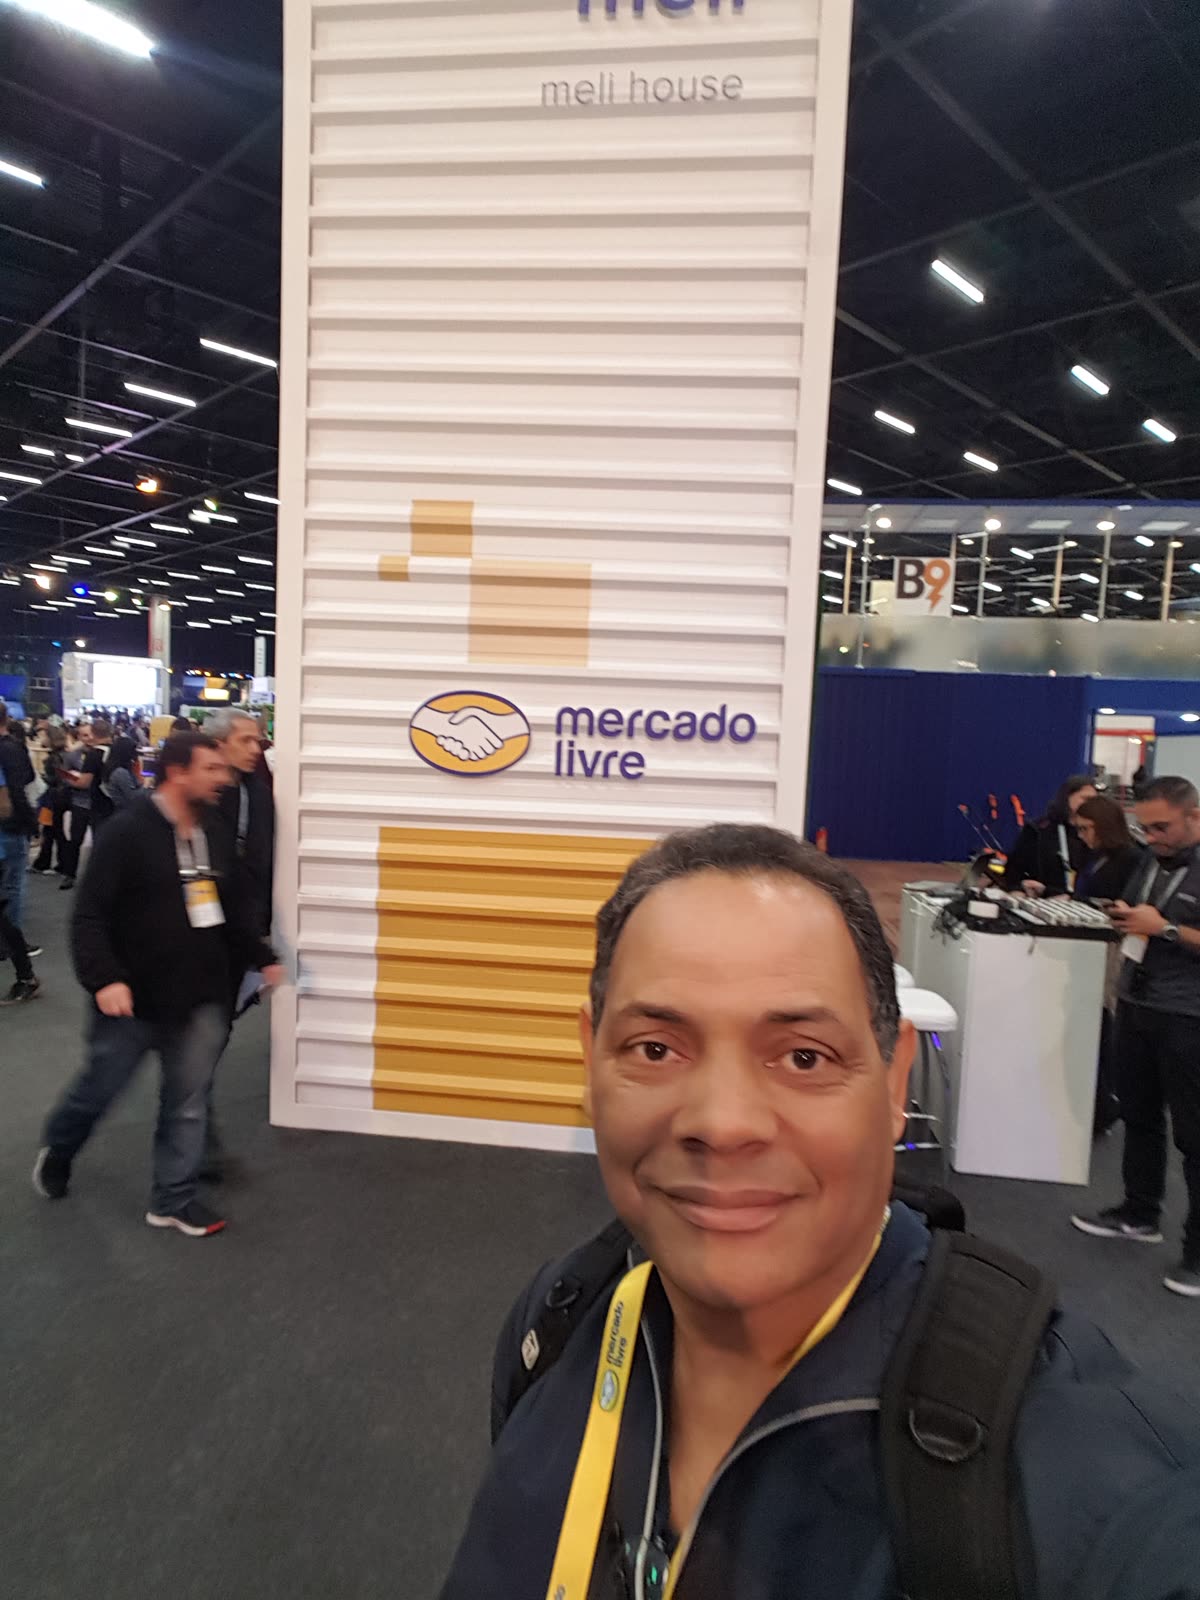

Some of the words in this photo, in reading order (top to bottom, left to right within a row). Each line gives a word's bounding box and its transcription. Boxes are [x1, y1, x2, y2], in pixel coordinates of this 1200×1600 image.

[541, 71, 615, 107] meli
[629, 70, 744, 103] house
[896, 558, 951, 613] B9
[555, 704, 757, 743] mercado
[554, 740, 646, 780] livre
[607, 1301, 624, 1364] mercado
